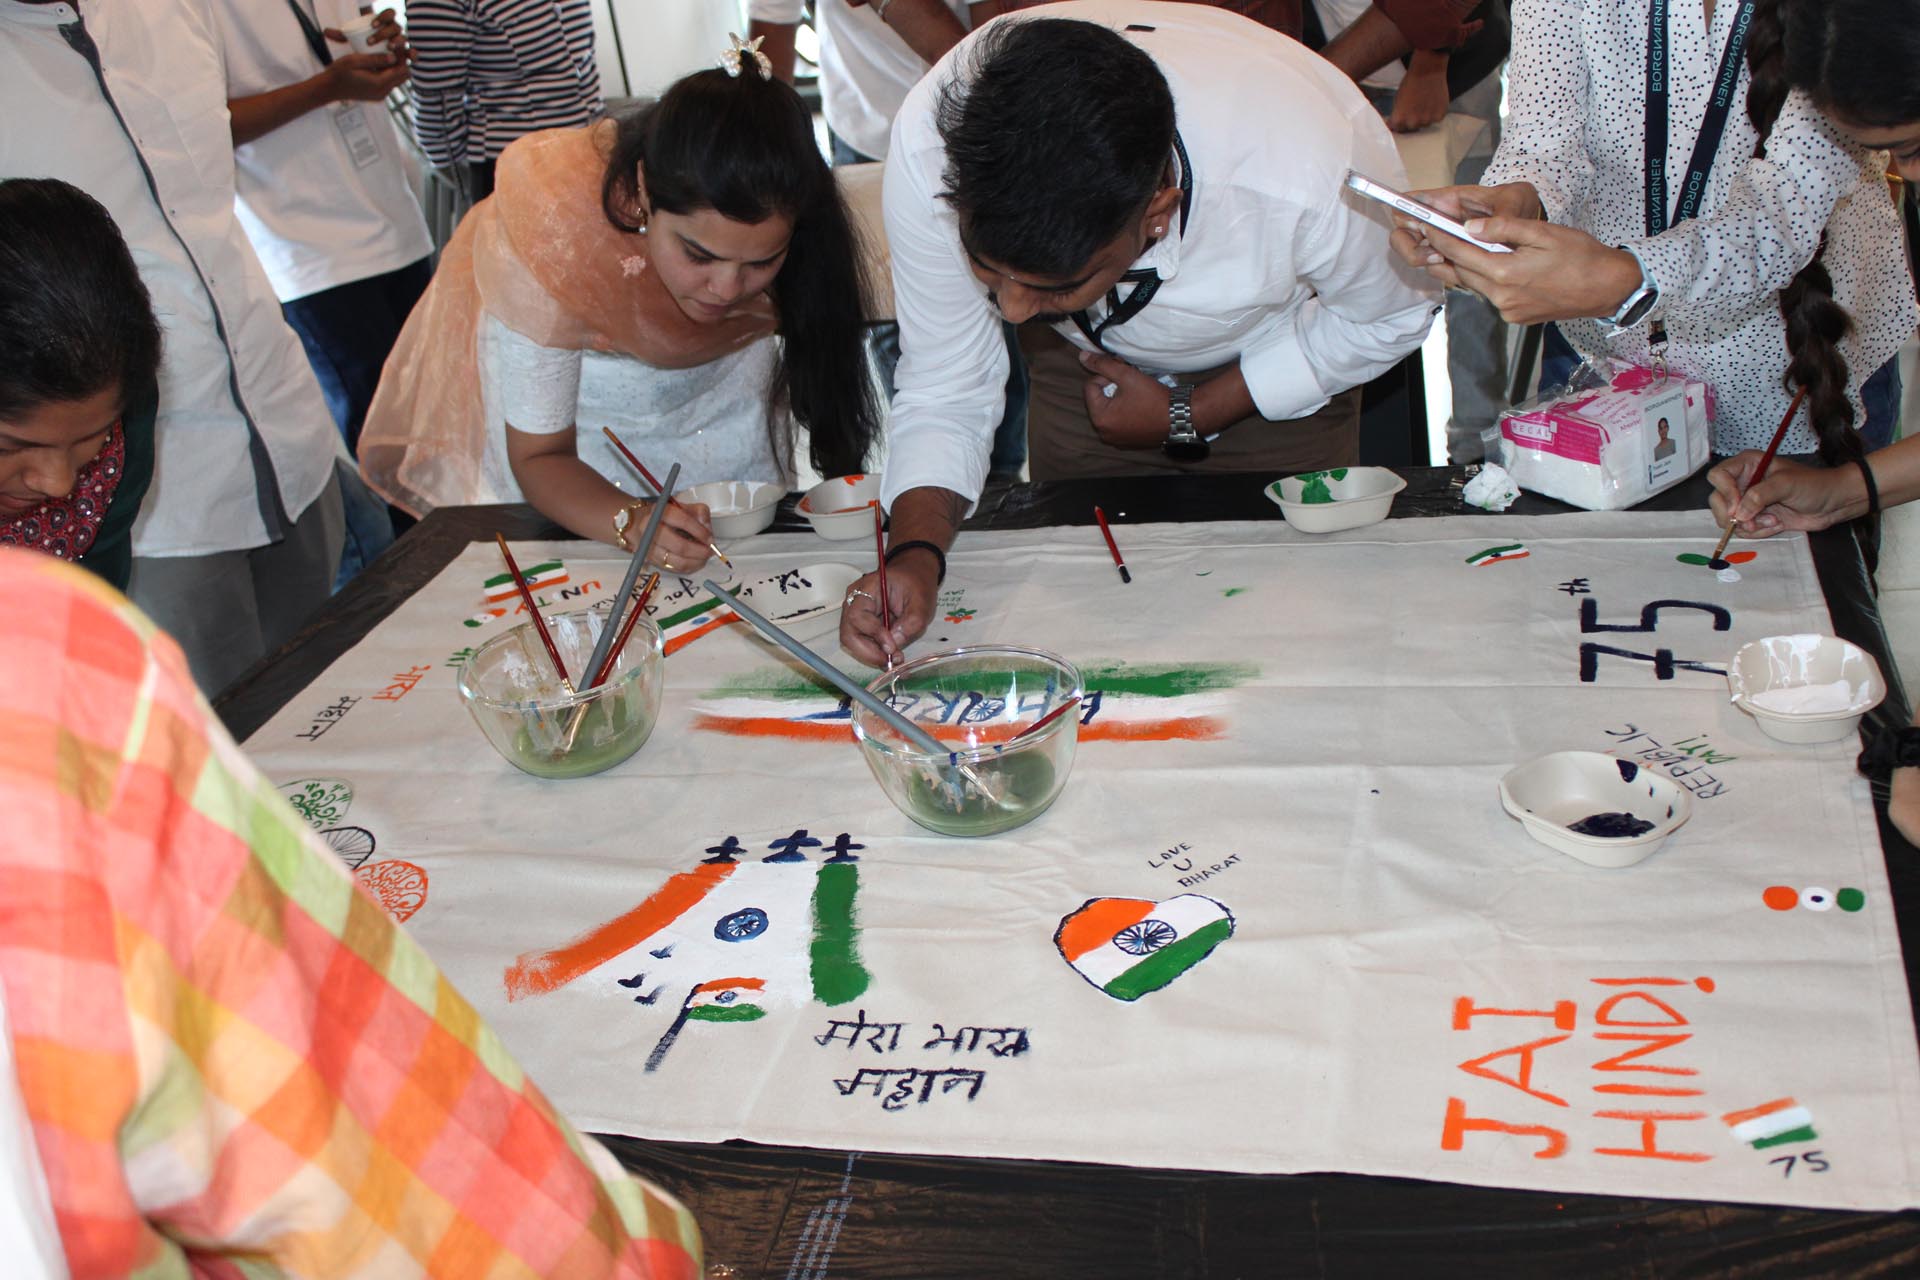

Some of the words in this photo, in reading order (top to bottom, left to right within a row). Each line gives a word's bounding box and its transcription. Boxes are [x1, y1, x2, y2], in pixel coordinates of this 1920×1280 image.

[1714, 2, 1755, 108] BORGWARNER
[1148, 842, 1192, 868] LOVE
[1177, 853, 1242, 887] BHARAT
[833, 1067, 986, 1111] महान
[1441, 996, 1577, 1159] JAI
[1769, 1150, 1830, 1179] 75
